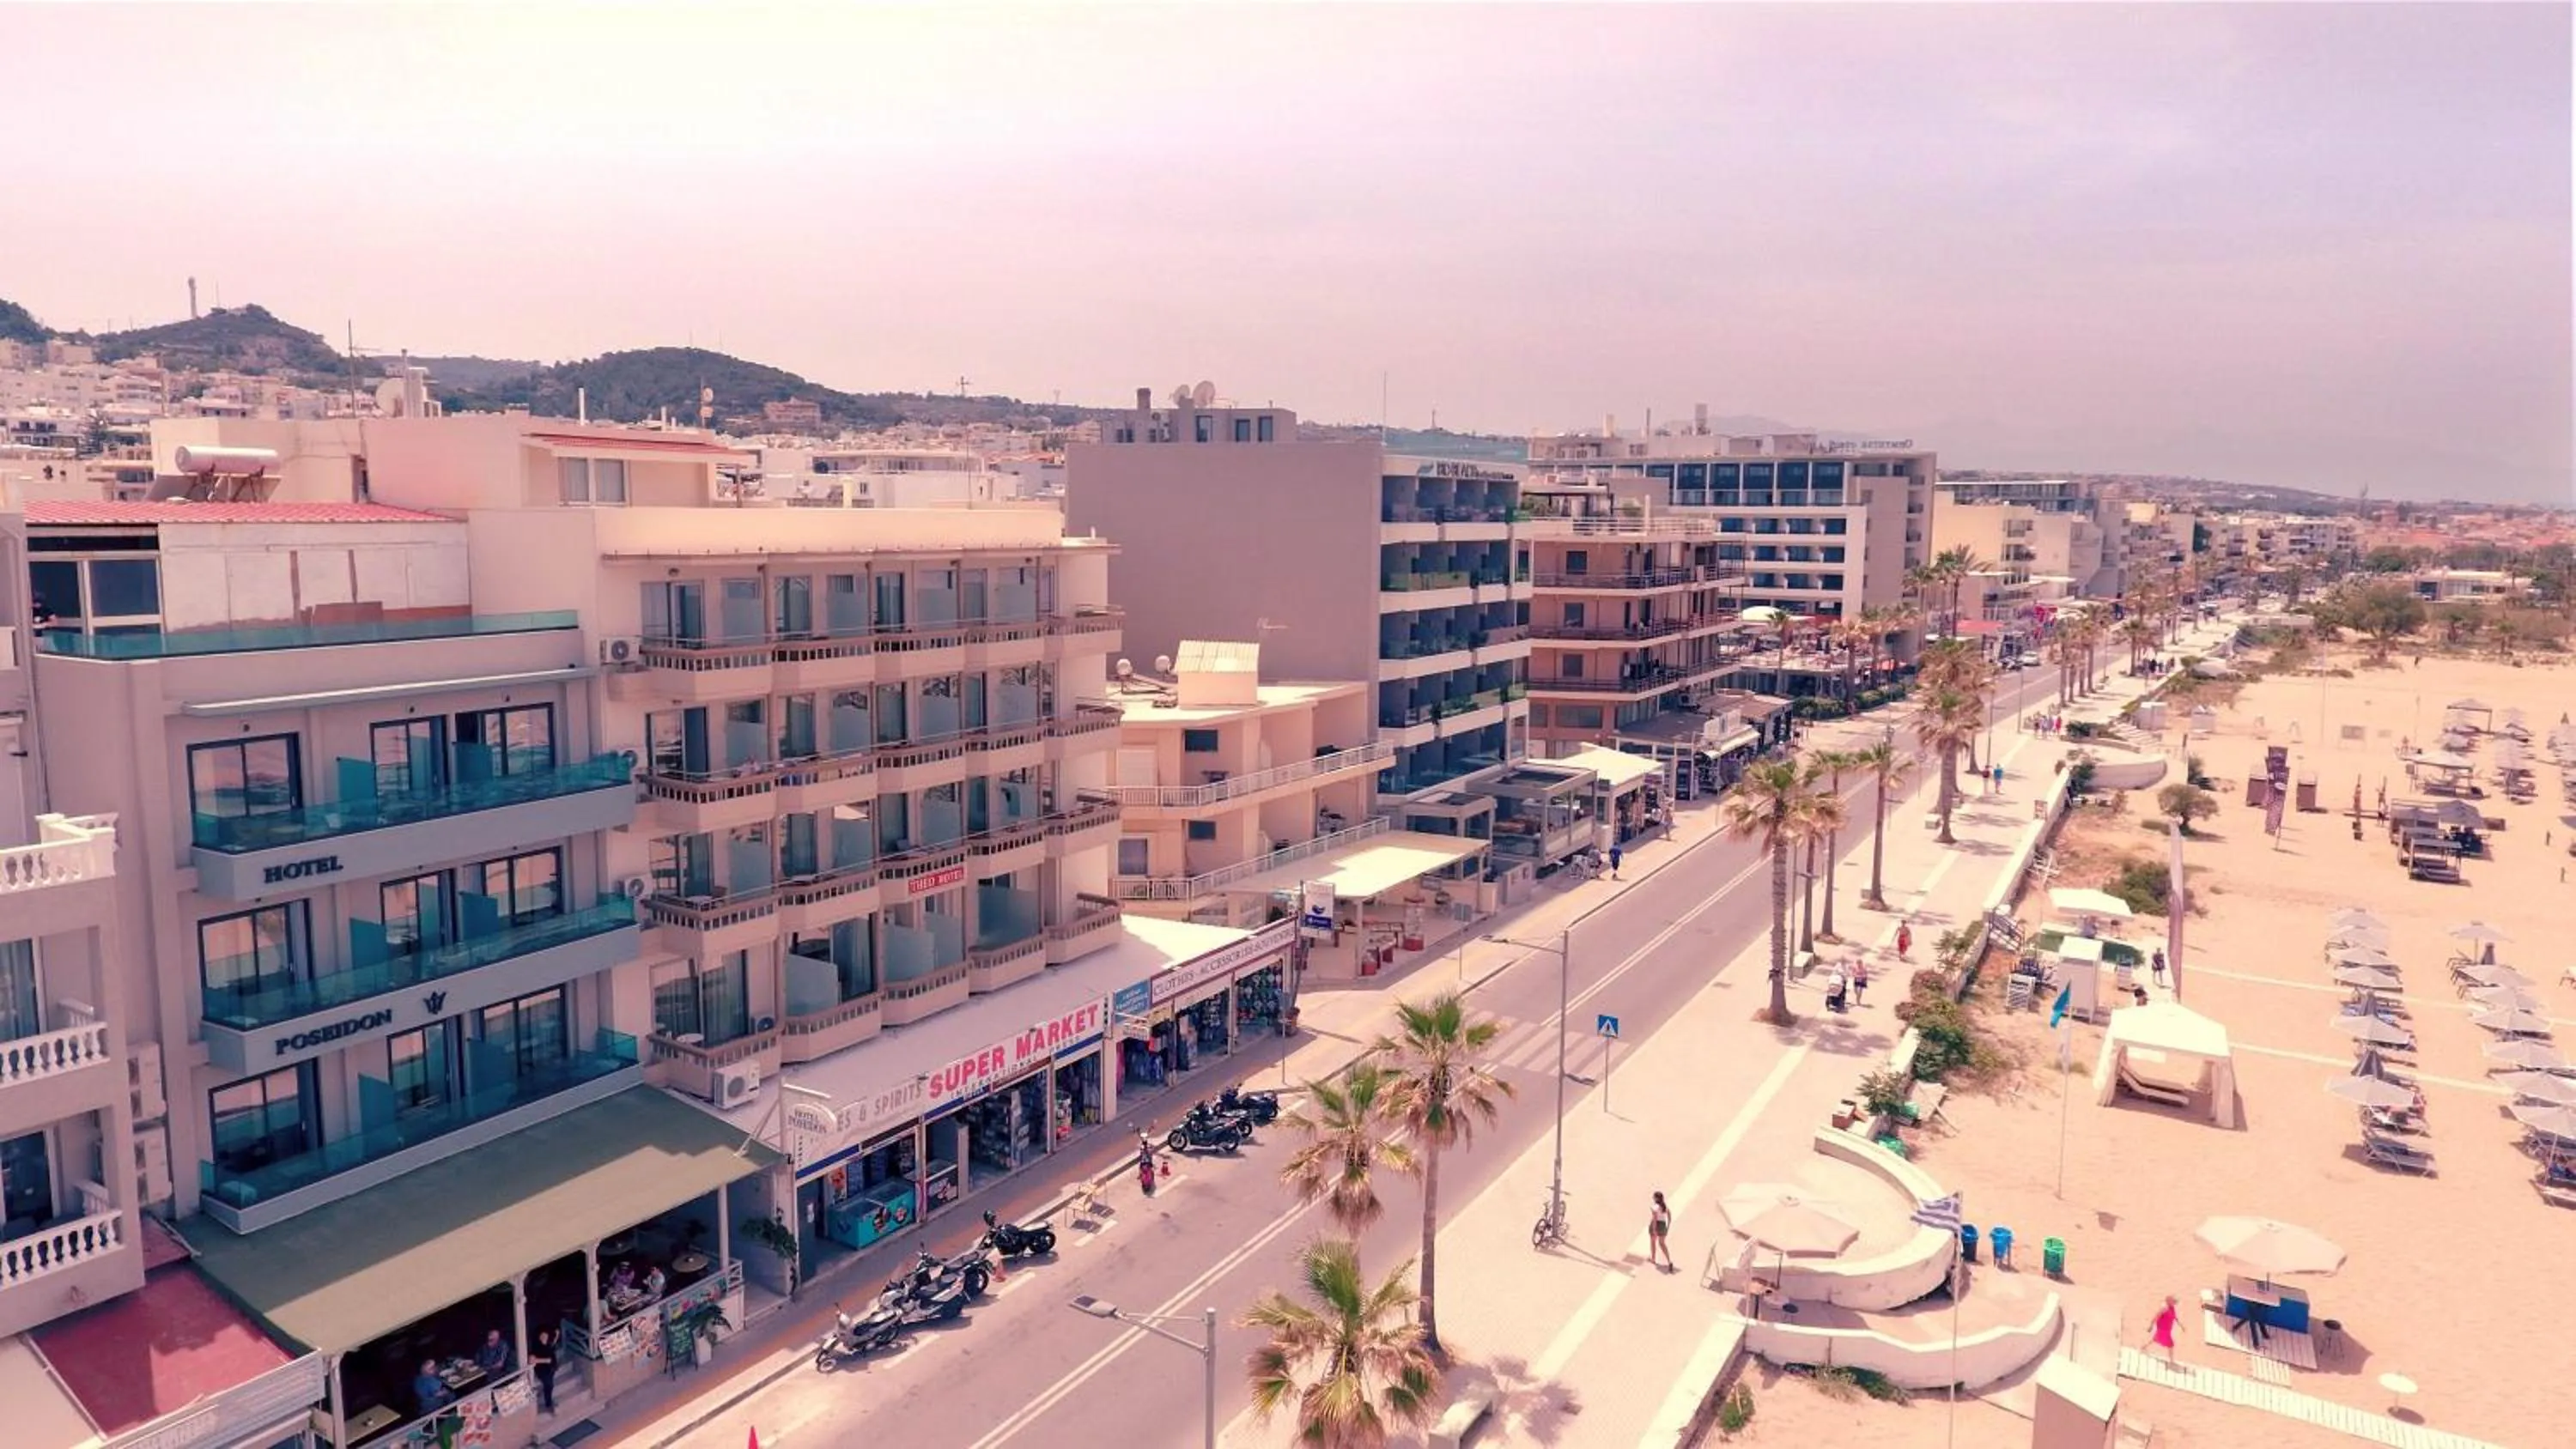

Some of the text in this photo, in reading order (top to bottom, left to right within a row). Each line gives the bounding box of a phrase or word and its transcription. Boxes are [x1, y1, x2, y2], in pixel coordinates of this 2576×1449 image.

[264, 856, 343, 883] HOTEL
[275, 1009, 392, 1056] POSEIDON
[929, 1045, 1005, 1100] SUPER
[1016, 1003, 1098, 1060] MARKET
[874, 1082, 923, 1116] SPIRITS
